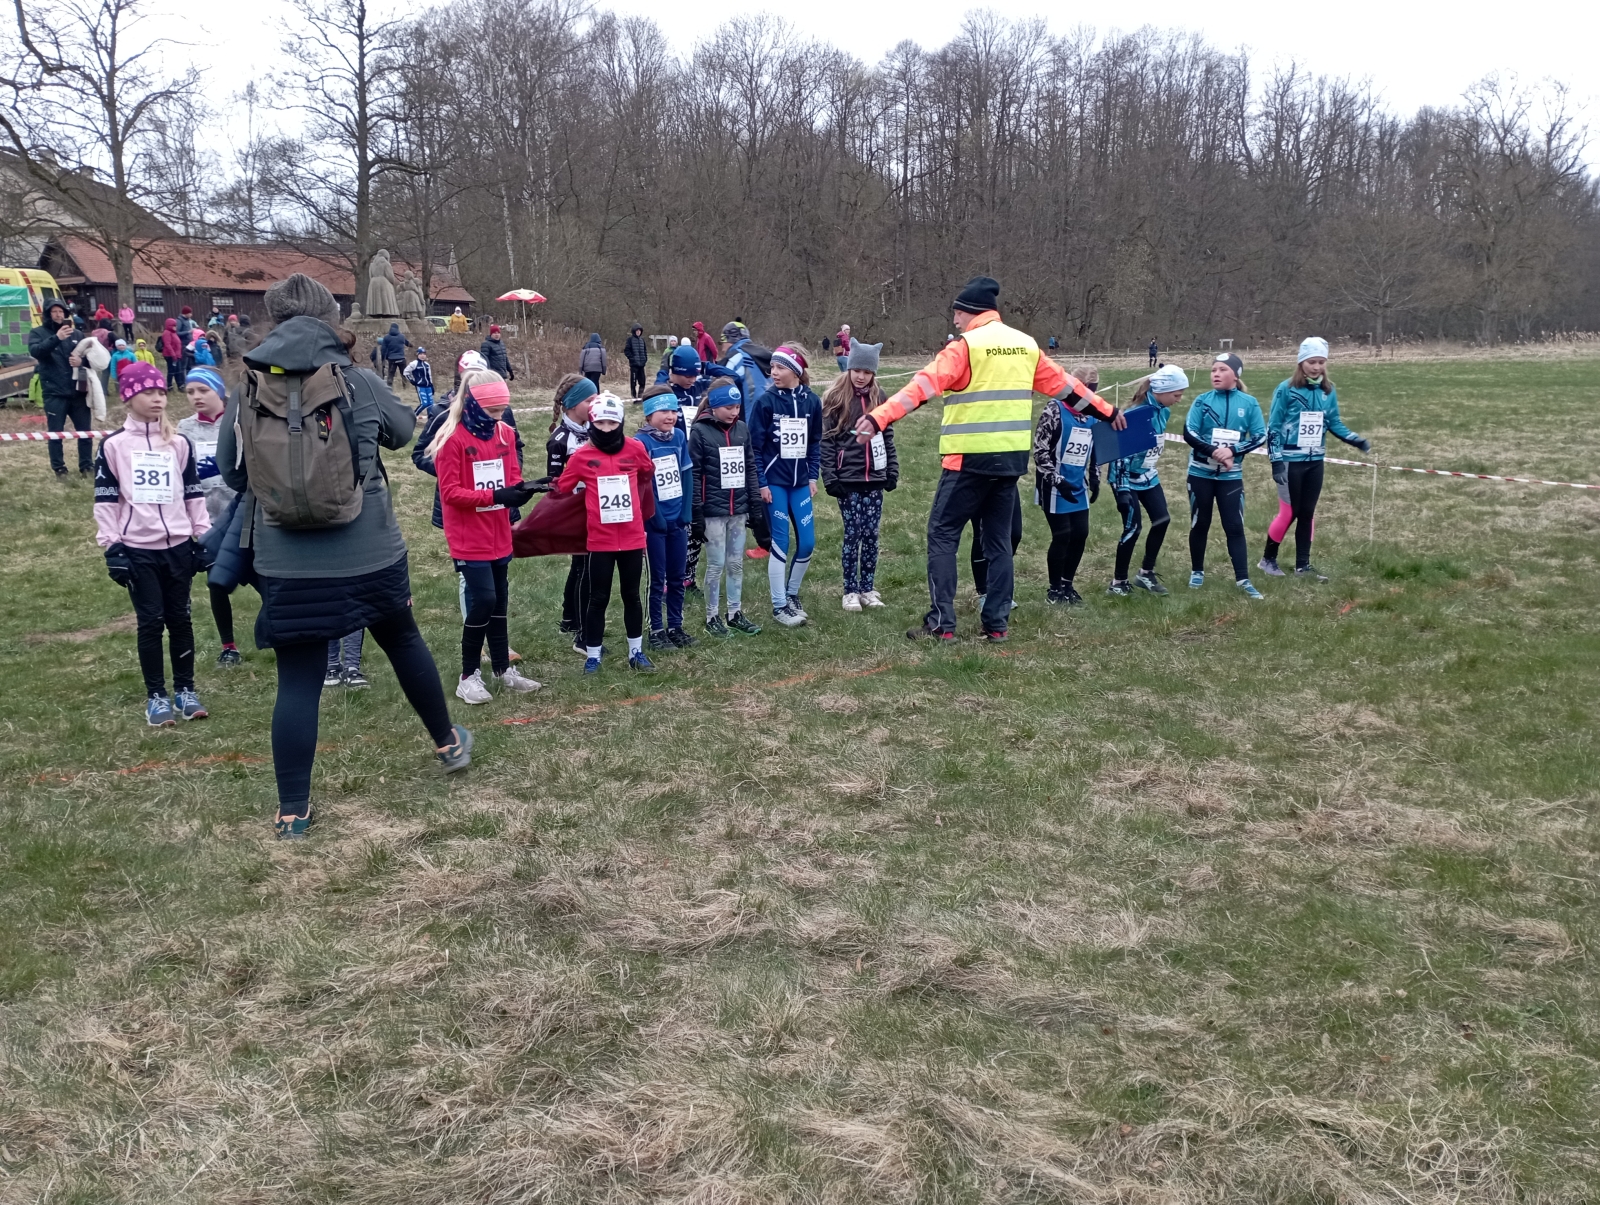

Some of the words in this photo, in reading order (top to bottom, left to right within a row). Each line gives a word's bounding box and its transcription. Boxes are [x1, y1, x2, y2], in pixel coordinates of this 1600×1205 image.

[986, 346, 1028, 356] POŘADATEL
[1300, 424, 1322, 435] 387
[781, 433, 805, 445] 391
[1066, 442, 1089, 455] 239
[721, 461, 744, 475] 386
[133, 469, 170, 487] 381
[656, 470, 680, 487] 398
[600, 493, 631, 509] 248
